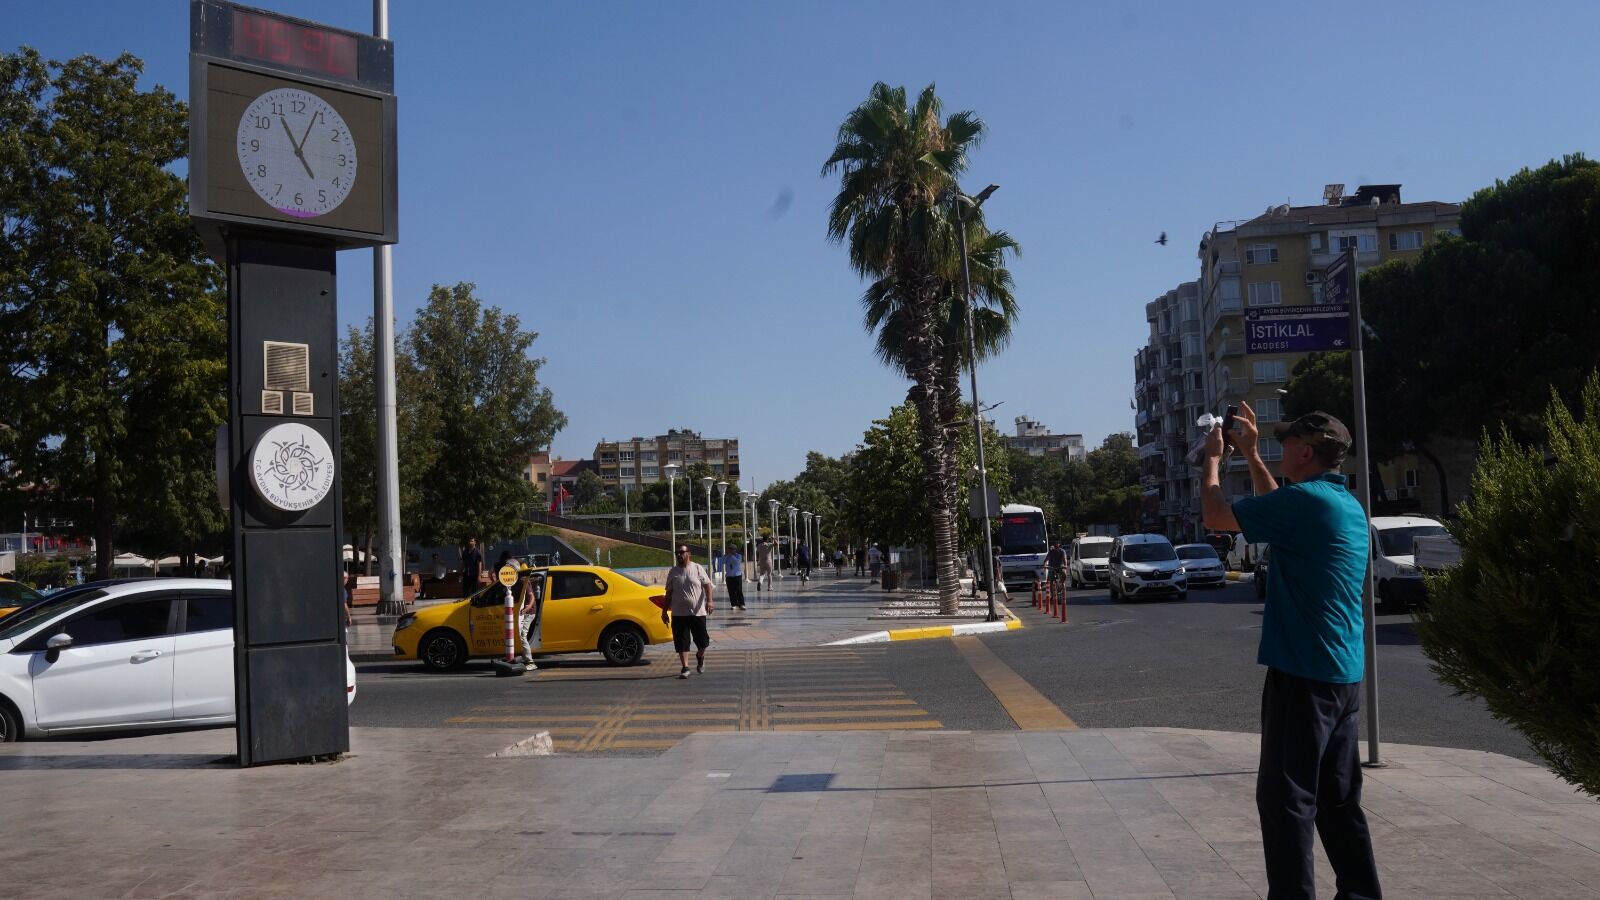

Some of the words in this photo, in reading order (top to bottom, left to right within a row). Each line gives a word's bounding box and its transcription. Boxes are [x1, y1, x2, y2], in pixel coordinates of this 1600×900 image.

[271, 102, 286, 117] 11
[290, 100, 306, 115] 12
[255, 116, 270, 130] 10
[319, 112, 326, 125] 1
[331, 129, 340, 143] 2
[250, 139, 260, 153] 9
[338, 154, 346, 167] 3
[257, 164, 267, 178] 8
[331, 176, 341, 189] 4
[274, 183, 283, 197] 7
[318, 189, 326, 203] 5
[294, 192, 304, 206] 6
[1251, 322, 1314, 339] İSTİKLAL
[1251, 341, 1289, 350] CADDESİ
